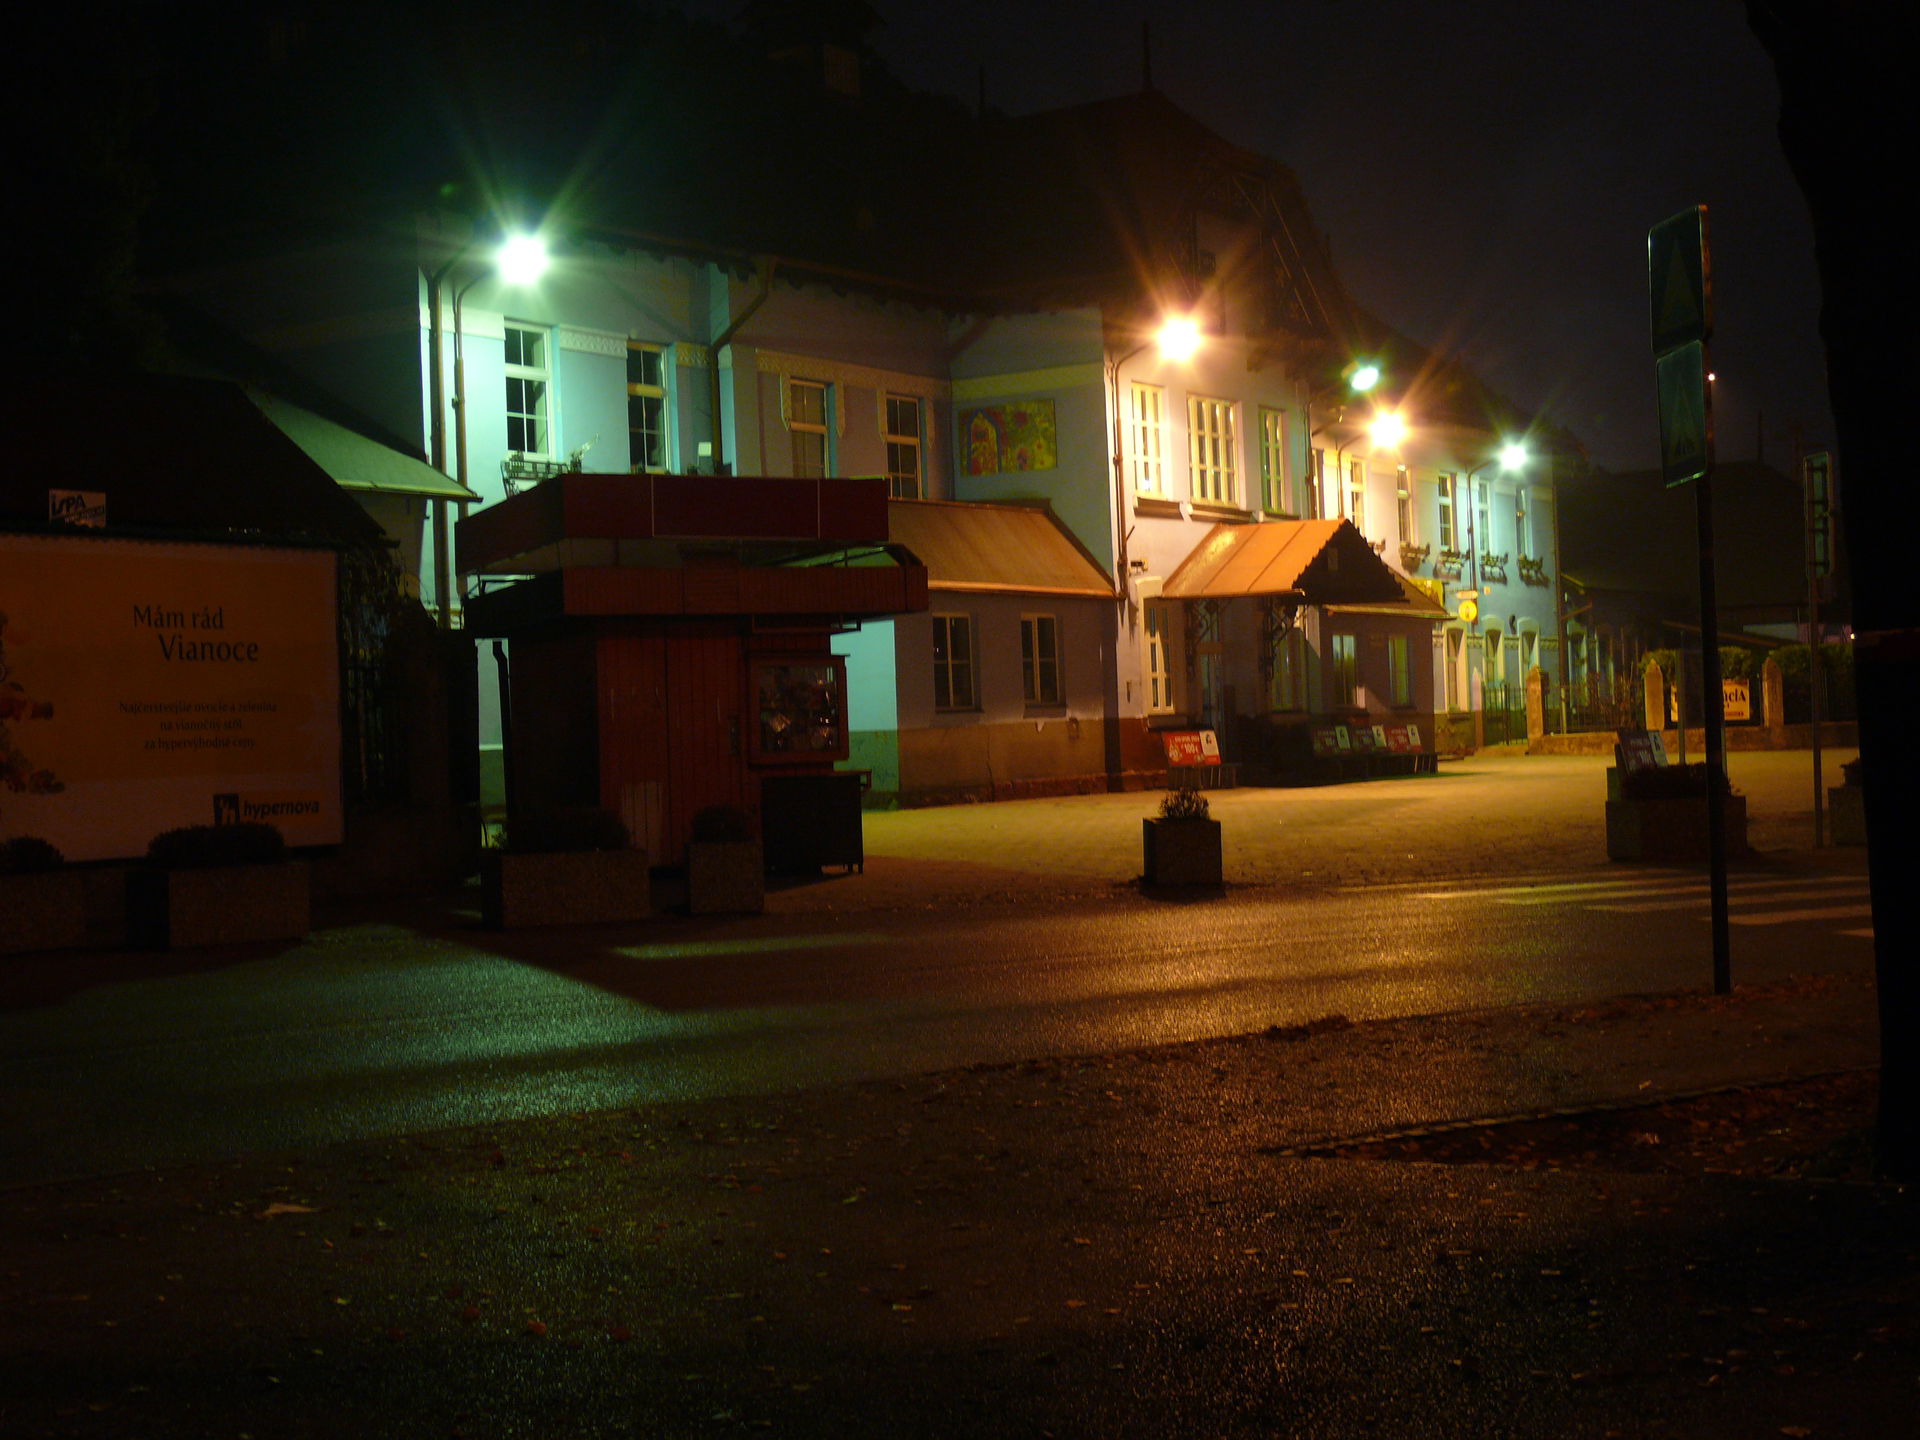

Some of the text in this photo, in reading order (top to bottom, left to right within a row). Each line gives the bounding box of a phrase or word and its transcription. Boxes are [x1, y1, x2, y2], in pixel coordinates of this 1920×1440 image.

[133, 604, 225, 629] Mám rád
[158, 633, 259, 662] Vianoce
[243, 800, 320, 819] hypernova
